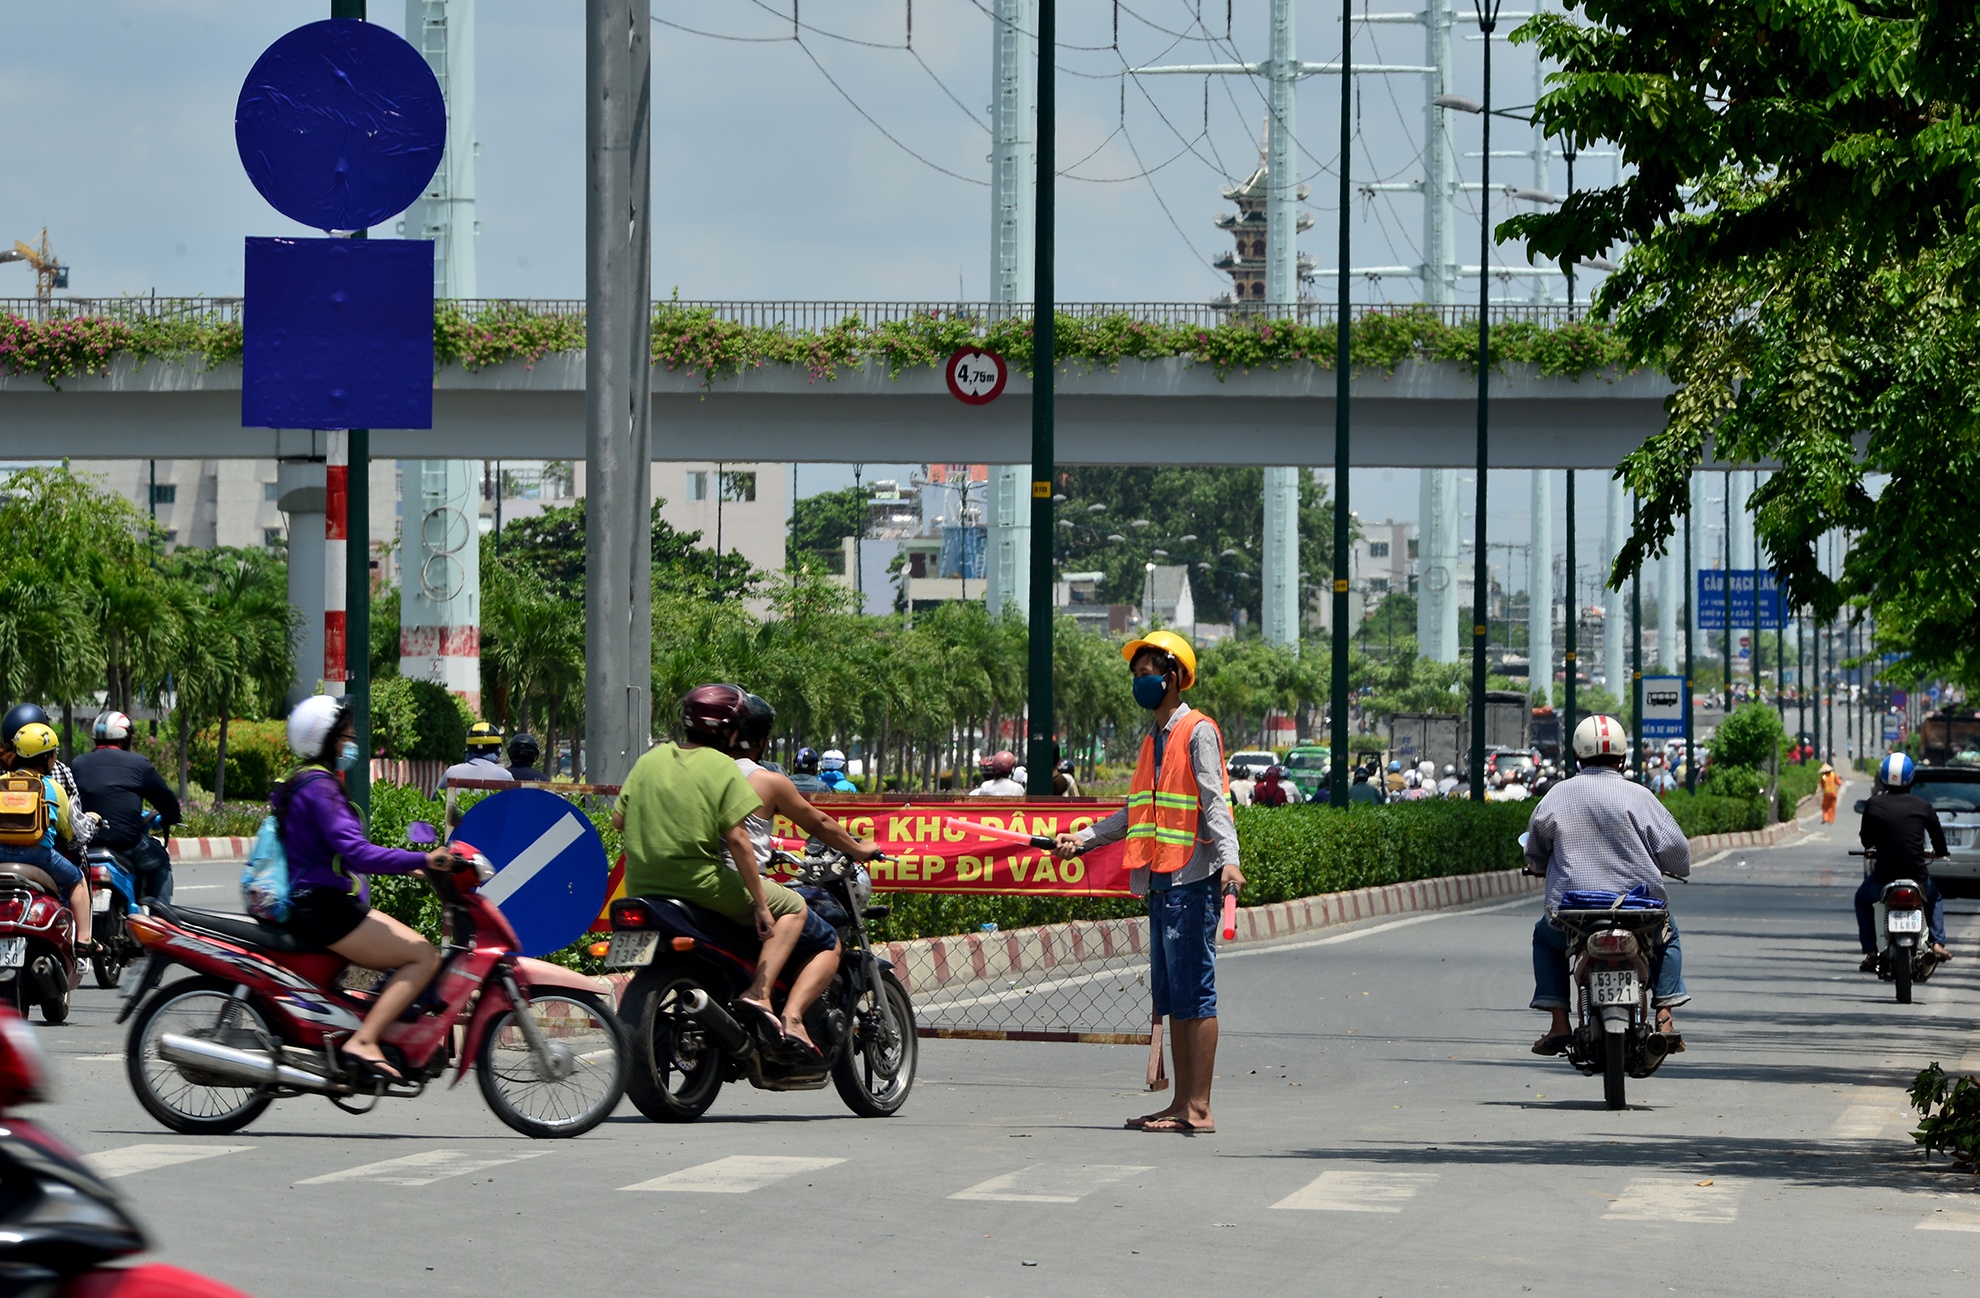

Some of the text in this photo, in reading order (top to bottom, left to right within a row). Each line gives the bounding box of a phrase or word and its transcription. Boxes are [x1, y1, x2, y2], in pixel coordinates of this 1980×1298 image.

[957, 363, 995, 386] 4,75m
[859, 848, 946, 881] HÉP
[955, 856, 994, 882] ĐI
[0, 953, 18, 964] 50
[1598, 987, 1632, 1002] 6521
